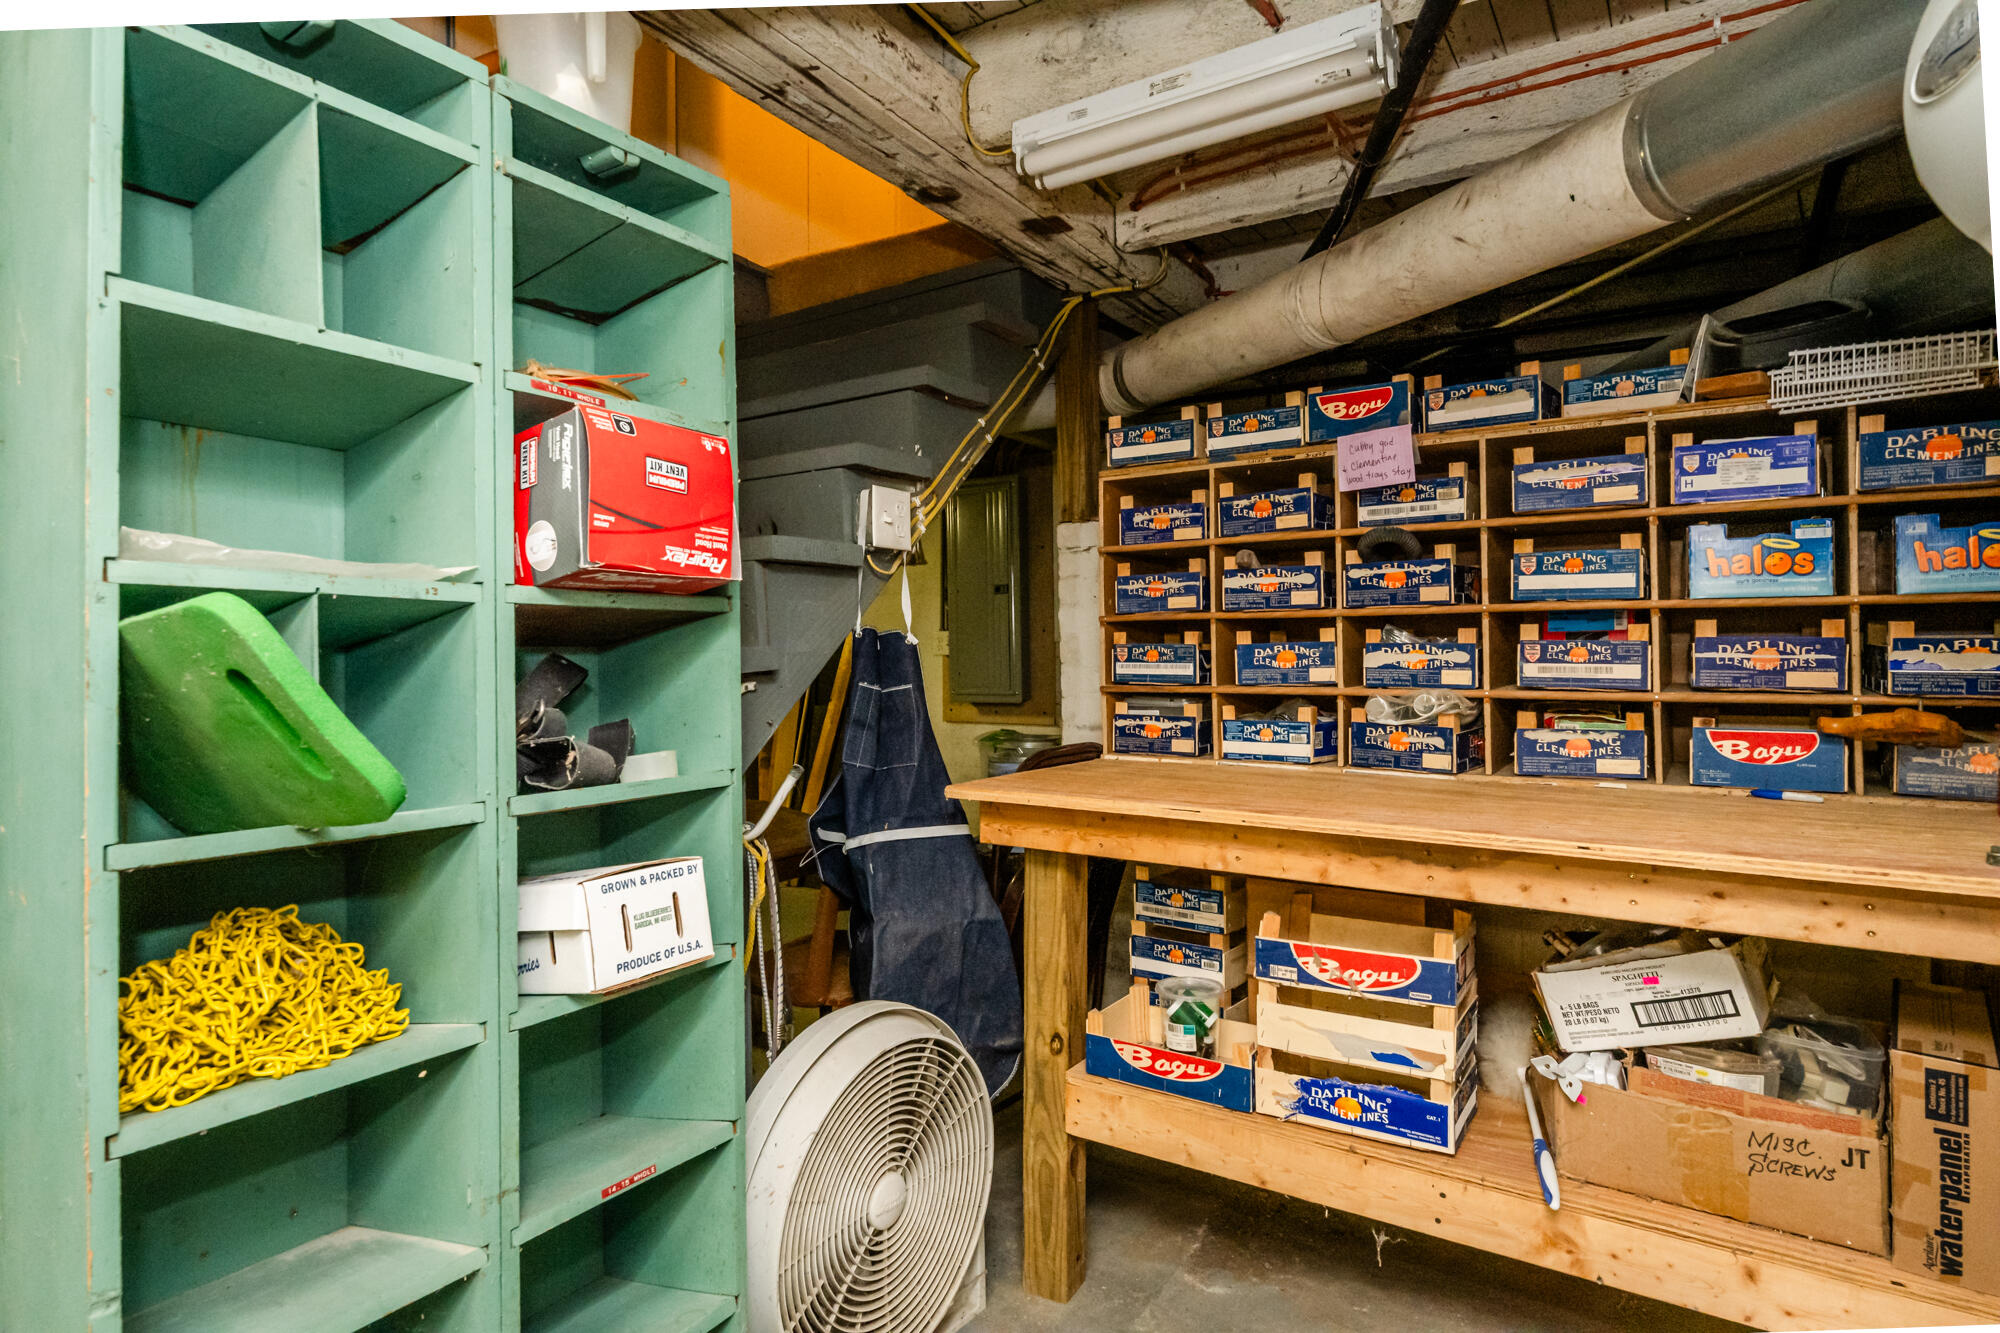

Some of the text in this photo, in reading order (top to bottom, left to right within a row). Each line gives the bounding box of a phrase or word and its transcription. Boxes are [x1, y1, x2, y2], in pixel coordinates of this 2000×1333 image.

[1592, 382, 1656, 397] CLEMENTINES
[1593, 374, 1656, 390] DARLING
[1450, 383, 1507, 398] DARLING
[1229, 413, 1275, 426] DARLING
[1128, 425, 1171, 437] DARLING
[1708, 447, 1774, 460] DARLING
[650, 460, 685, 478] VENT KIT
[1684, 479, 1694, 489] H
[1232, 503, 1295, 518] CLEMENTINES
[1133, 517, 1191, 530] CLEMENTINES
[1543, 552, 1607, 564] DARLING
[1705, 543, 1815, 577] halos
[1542, 563, 1607, 574] CLEMENTINES
[1360, 575, 1432, 589] CLEMENTINES
[1128, 586, 1185, 598] CLEMENTINES
[1132, 645, 1174, 655] DARLING
[1254, 644, 1320, 657] DARLING
[1548, 641, 1612, 654] DARLING
[1717, 640, 1815, 655] DARLING
[1253, 657, 1321, 669] CLEMENTINES
[1547, 652, 1612, 663] CLEMENTINES
[1715, 656, 1817, 671] CLEMENTINES
[1125, 726, 1182, 738] CLEMENTINES
[1244, 723, 1289, 734] DARLING
[1365, 736, 1435, 751] CLEMENTINES
[1536, 743, 1622, 758] CLEMENTINES
[1712, 739, 1808, 764] Bagu
[601, 864, 698, 894] GROWN & PACKED BY
[1154, 887, 1199, 902] DARLING
[616, 939, 704, 974] PRODUCE OF U.S.A.
[1154, 943, 1201, 959] DARLING
[1582, 1001, 1600, 1009] BAGS
[1603, 1007, 1620, 1015] NETO
[1117, 1043, 1212, 1079] Bagu
[1311, 1086, 1388, 1114] DARLING
[1308, 1096, 1390, 1125] CLEMENTINES
[1840, 1147, 1871, 1170] JT
[1963, 1133, 1971, 1195] EVAPORATOR
[1747, 1152, 1837, 1181] SCREWS
[1933, 1127, 1970, 1277] waterpanel
